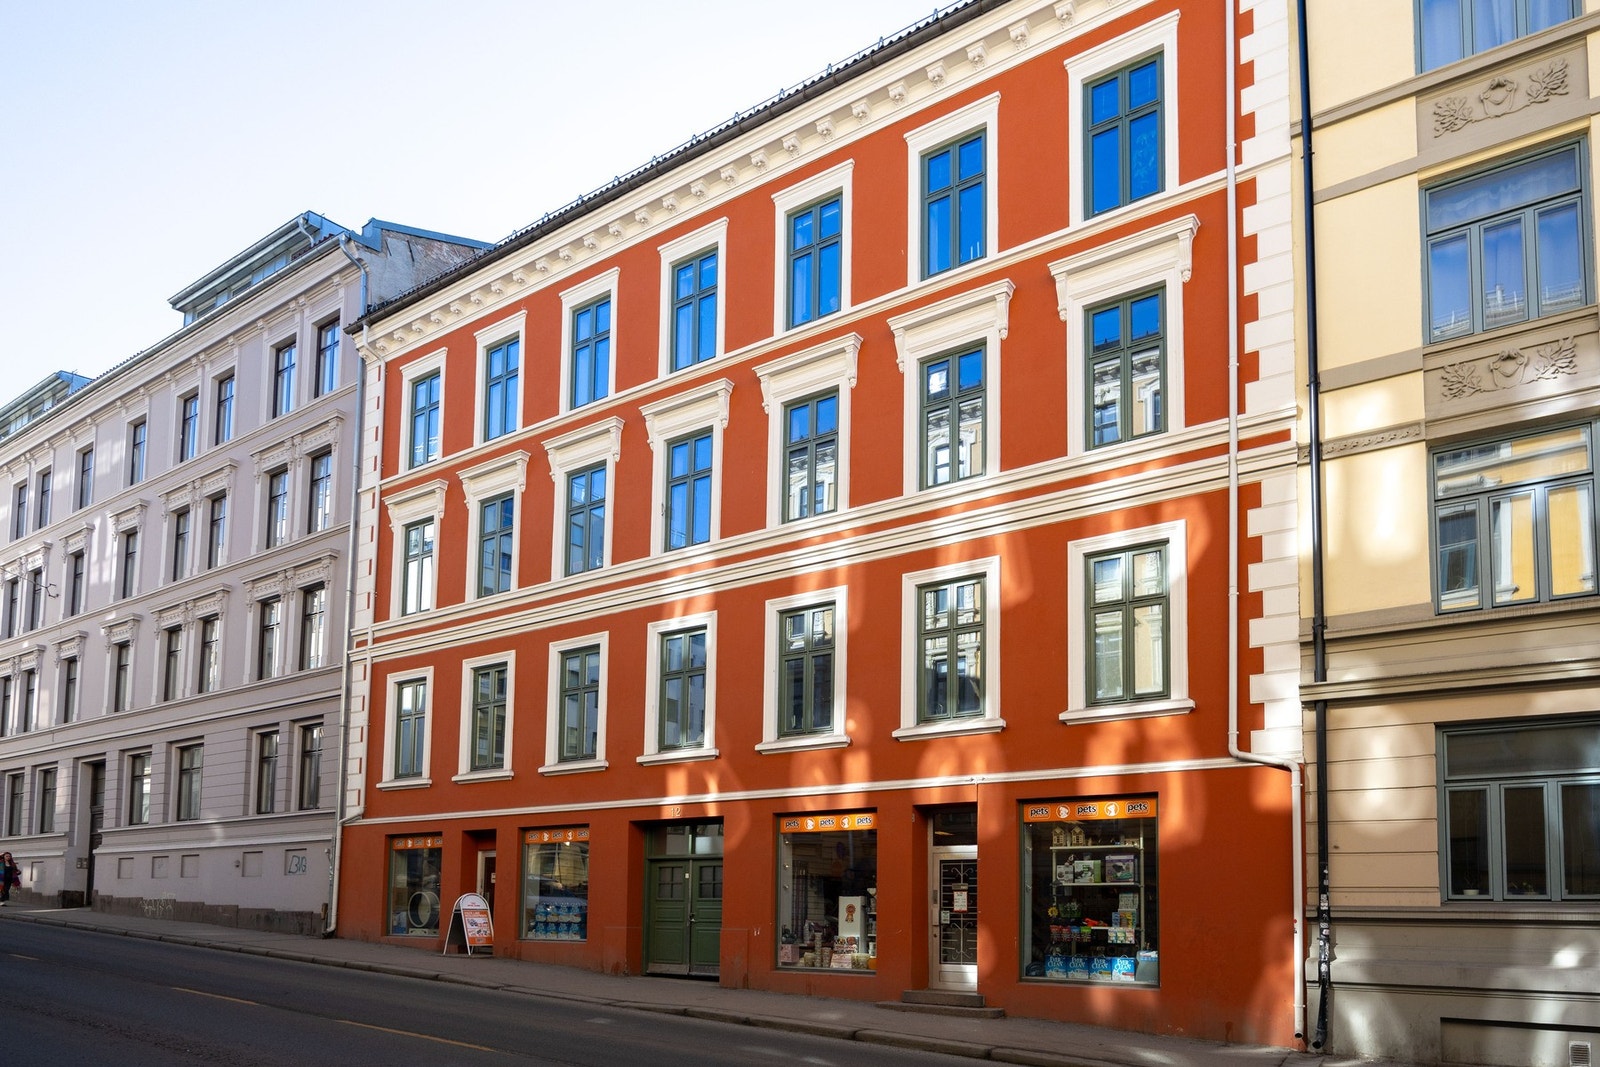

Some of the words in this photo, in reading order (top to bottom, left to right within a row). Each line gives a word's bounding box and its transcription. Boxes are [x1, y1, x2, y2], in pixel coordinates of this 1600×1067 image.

[671, 806, 681, 816] 12
[1030, 806, 1049, 816] pets
[1077, 804, 1096, 814] pets
[1127, 802, 1147, 812] pets
[820, 818, 834, 826] pets
[856, 816, 872, 824] pets
